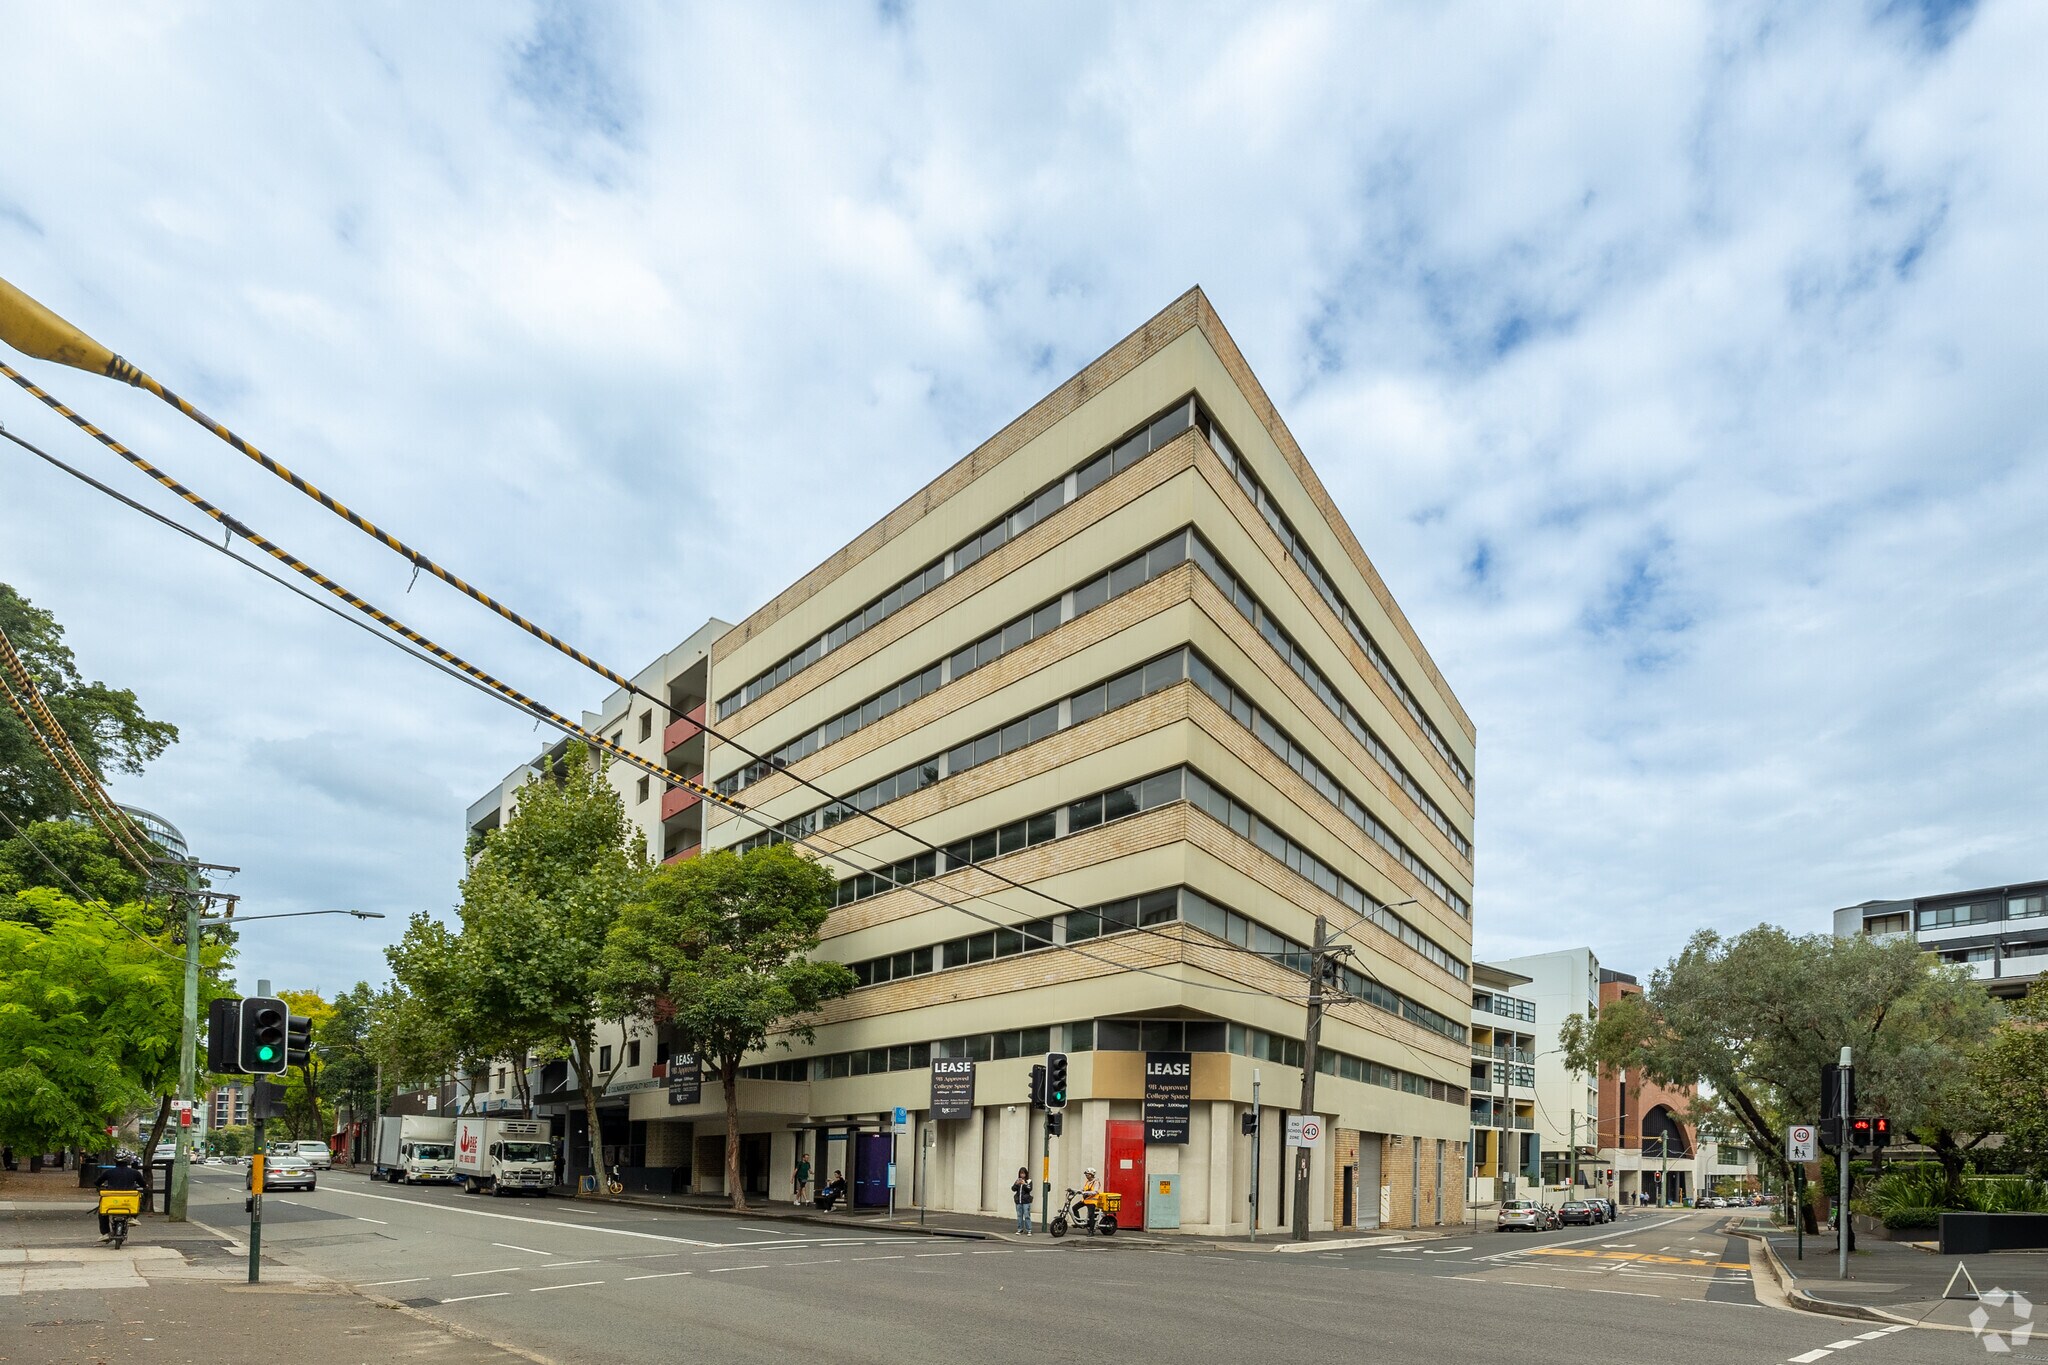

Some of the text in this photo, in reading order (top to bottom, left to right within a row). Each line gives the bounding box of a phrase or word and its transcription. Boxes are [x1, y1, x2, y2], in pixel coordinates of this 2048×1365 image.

[934, 1062, 971, 1073] LEASE
[1147, 1062, 1190, 1075] LEASE
[1304, 1127, 1317, 1136] 40
[1796, 1131, 1807, 1139] 40
